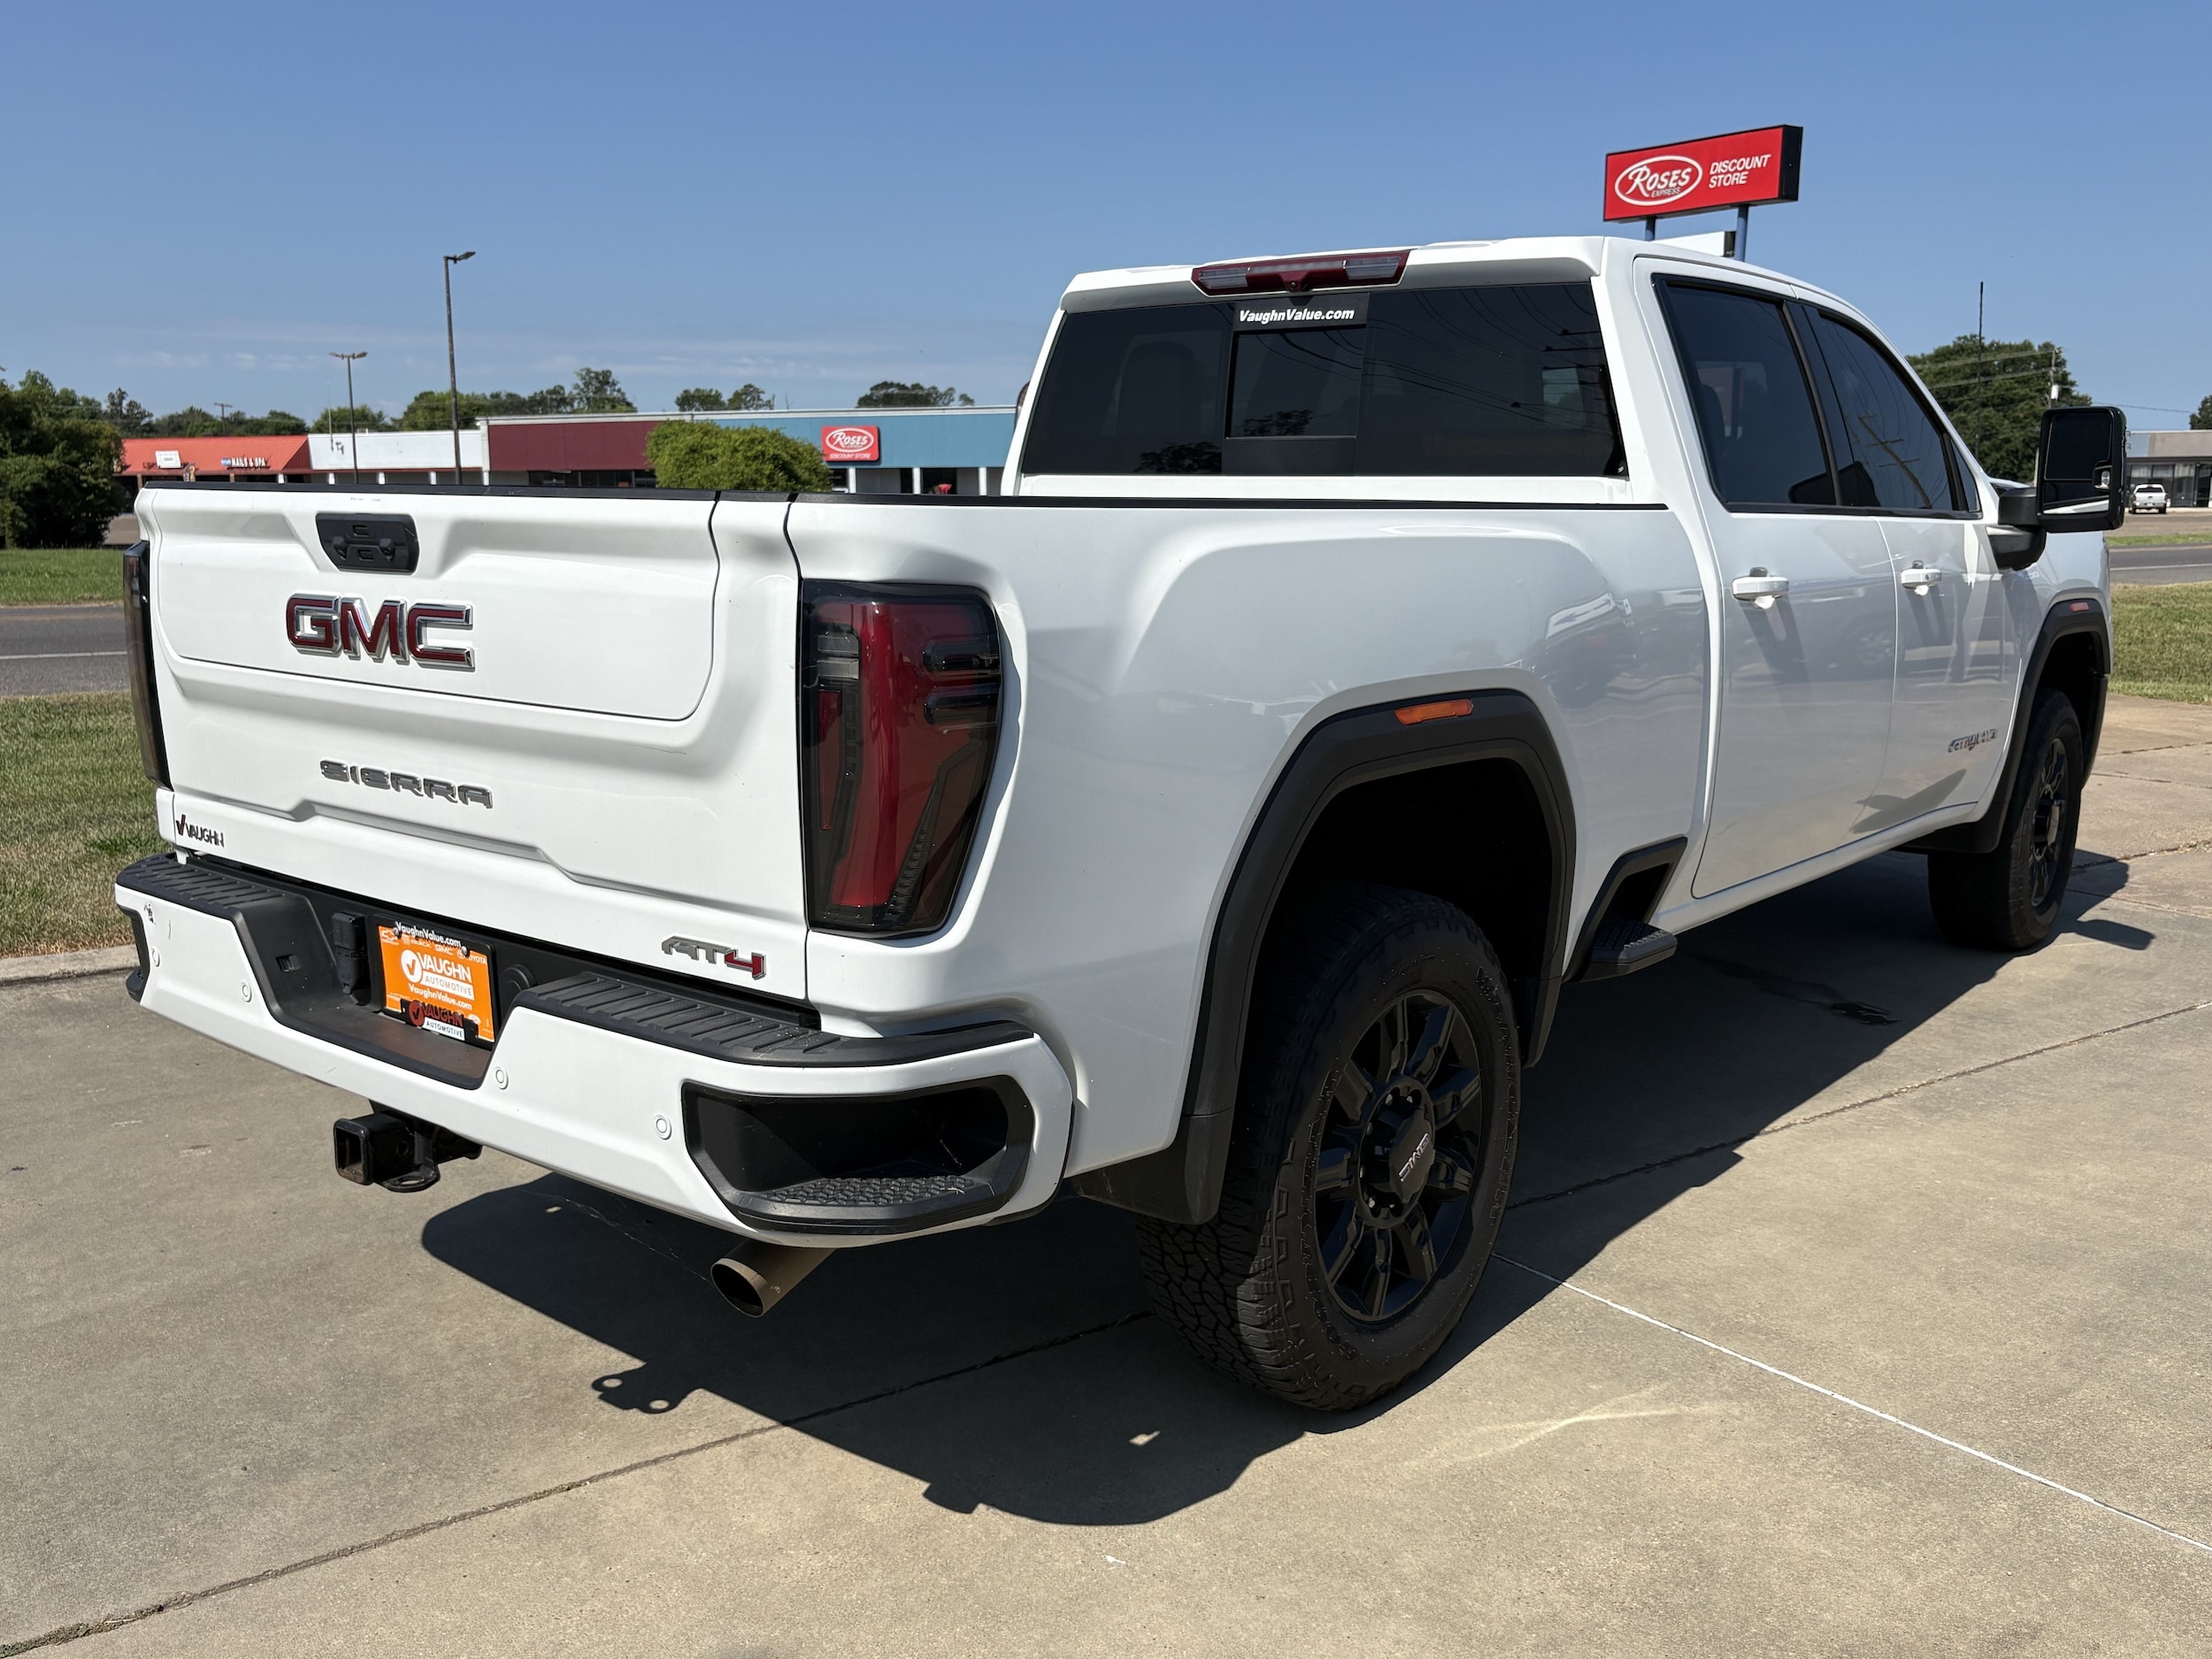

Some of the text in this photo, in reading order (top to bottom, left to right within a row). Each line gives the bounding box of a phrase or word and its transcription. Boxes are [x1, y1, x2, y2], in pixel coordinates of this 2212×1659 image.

[1709, 154, 1771, 174] DISCOUNT
[1709, 172, 1748, 188] STORE
[1240, 309, 1355, 325] VaughnValue.com
[286, 593, 475, 672] GMC
[319, 760, 493, 809] SIERRA
[395, 921, 462, 949] VaughnValue.com
[434, 945, 454, 956] GMC
[661, 935, 767, 980] AT4
[418, 952, 472, 983] VAUGHN
[408, 983, 473, 1010] VaughnValue.com
[425, 975, 472, 996] AUTOMOTIVE
[422, 1002, 464, 1027] VAUGHN
[426, 1021, 463, 1038] AUTOMOTIVE
[1398, 1133, 1430, 1183] GMC
